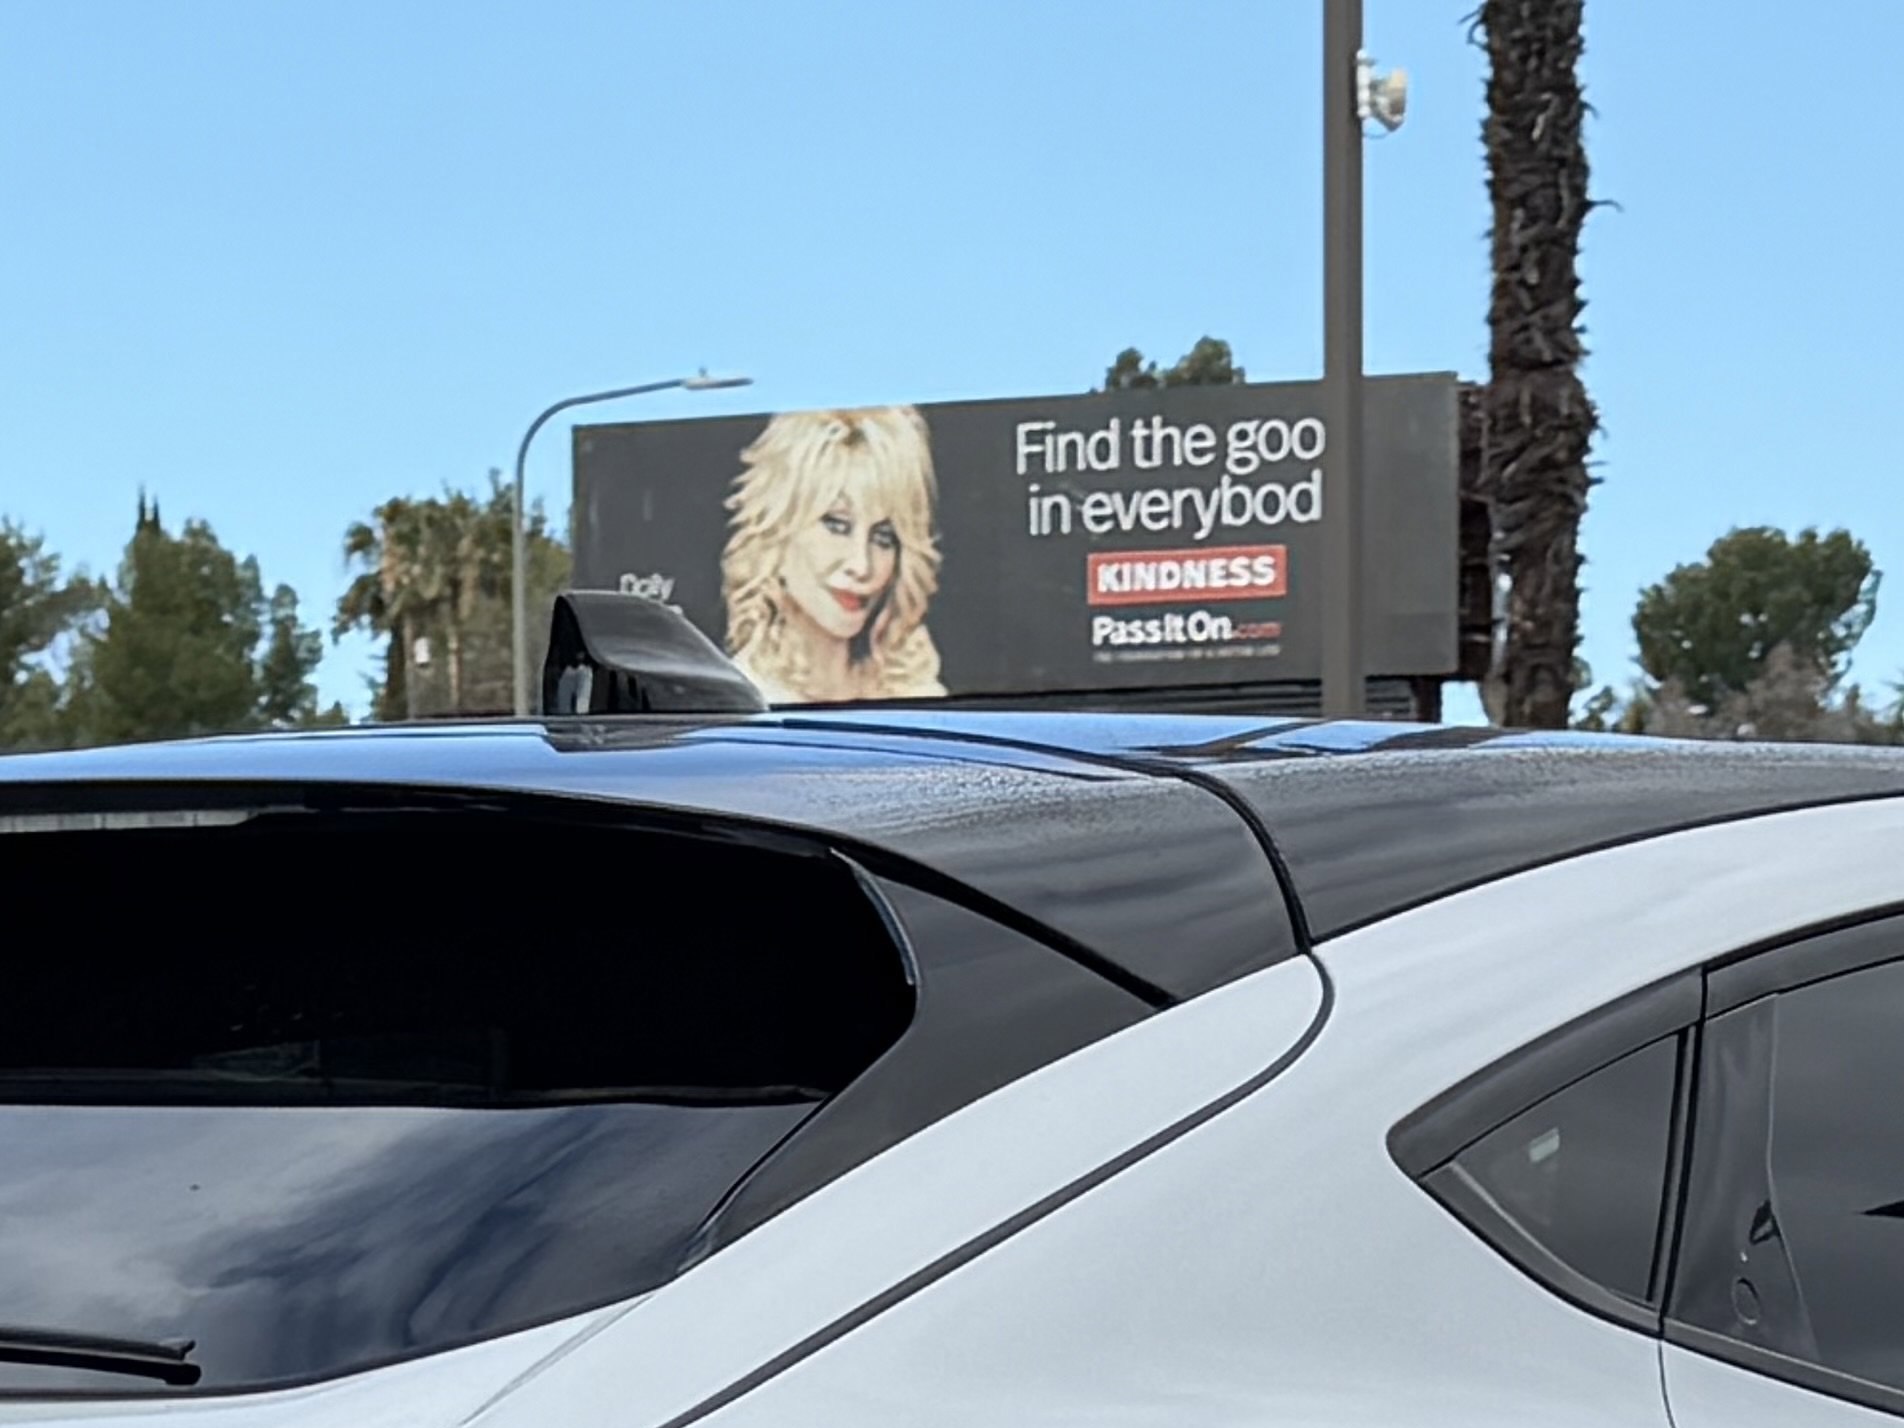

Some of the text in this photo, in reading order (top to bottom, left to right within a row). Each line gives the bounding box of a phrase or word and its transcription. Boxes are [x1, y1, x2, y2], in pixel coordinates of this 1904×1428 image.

[1016, 415, 1325, 475] Find the goo
[1028, 468, 1322, 540] in everybod
[1098, 556, 1276, 592] KINDNESS
